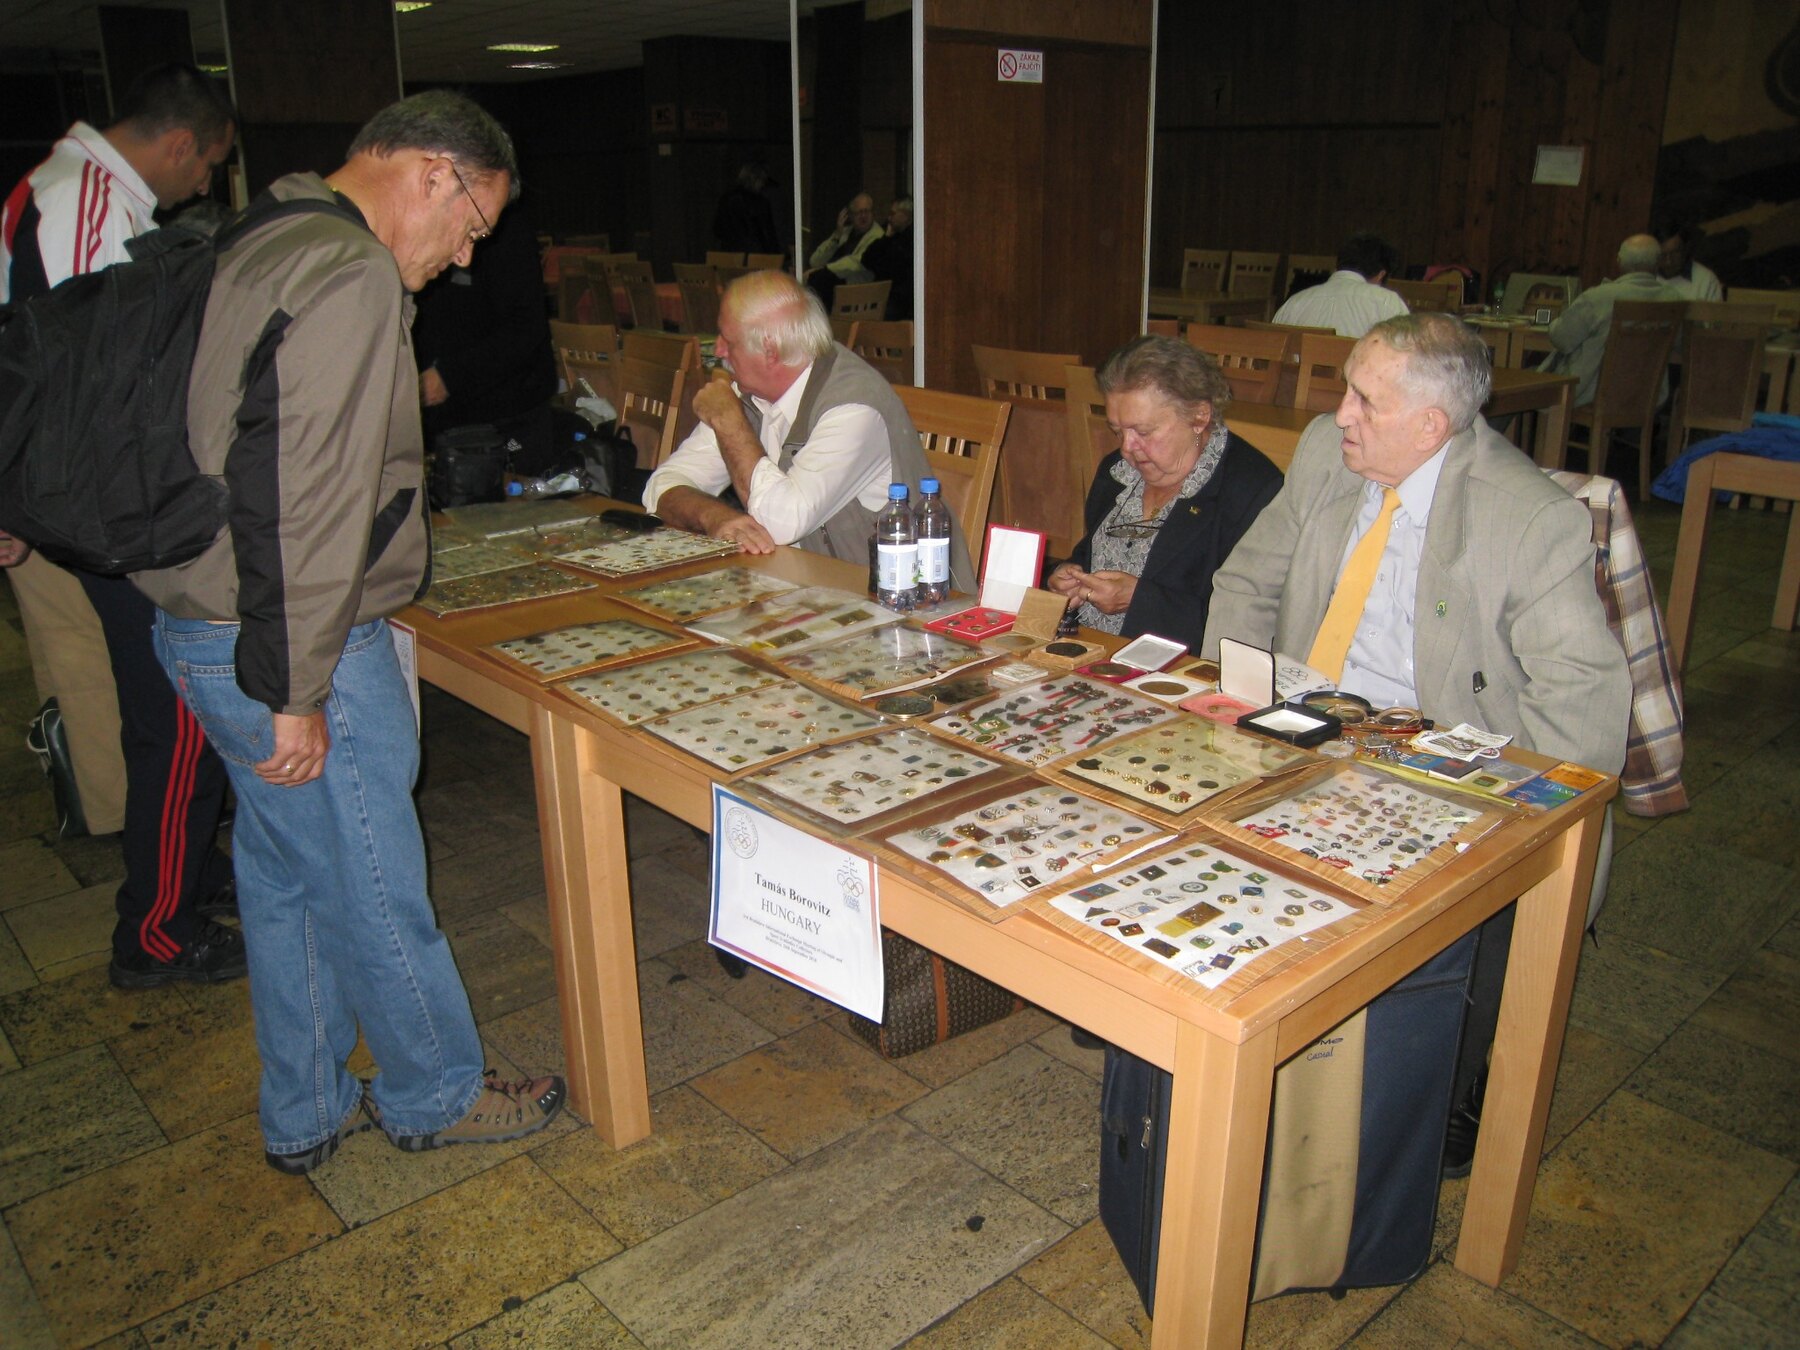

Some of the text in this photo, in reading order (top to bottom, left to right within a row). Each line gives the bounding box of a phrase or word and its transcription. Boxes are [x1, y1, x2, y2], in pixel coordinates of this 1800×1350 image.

[1020, 52, 1040, 61] ZÁKAZ
[754, 872, 786, 897] Tamás
[789, 888, 831, 917] Borovitz
[761, 898, 821, 935] HUNGARY
